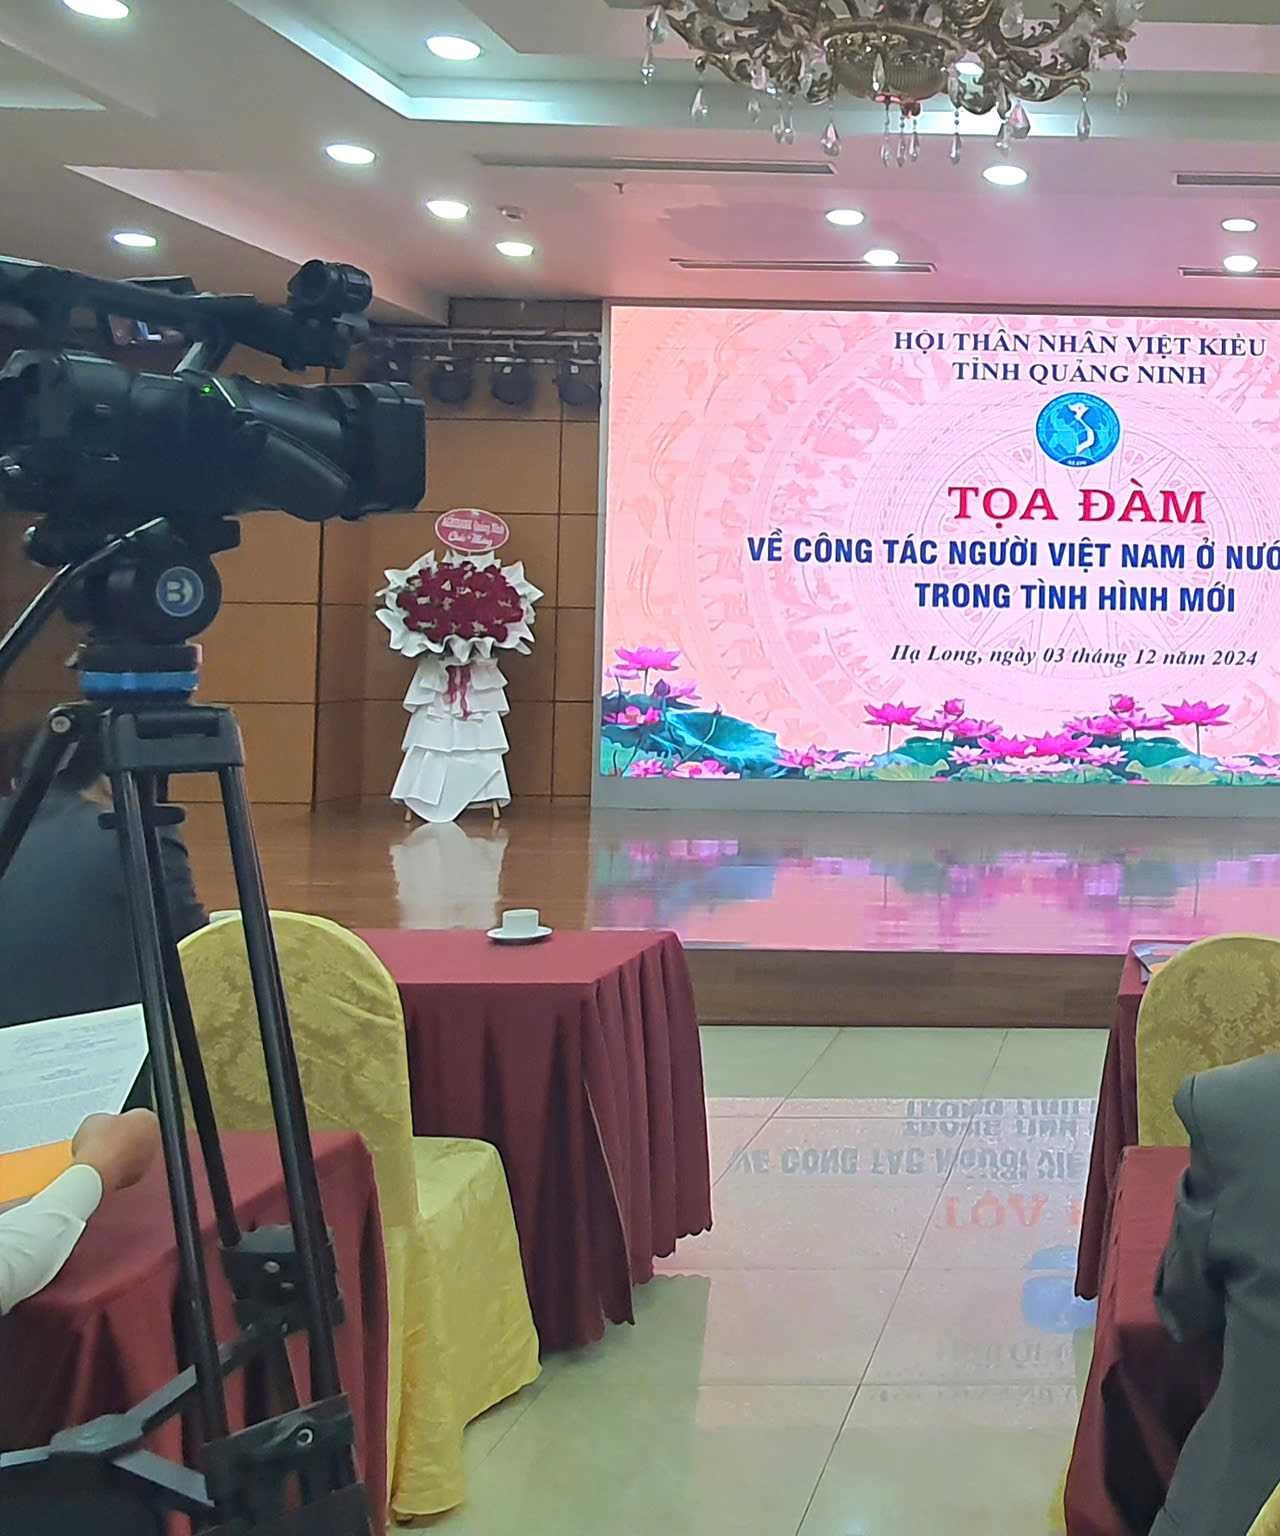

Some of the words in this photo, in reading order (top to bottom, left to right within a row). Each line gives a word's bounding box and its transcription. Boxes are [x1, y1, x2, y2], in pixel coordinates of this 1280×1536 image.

[894, 330, 944, 354] HỘI
[953, 329, 1029, 351] THÂN
[1039, 331, 1117, 353] NHÂN
[1126, 334, 1191, 359] VIỆT
[1029, 359, 1129, 385] QUẢNG
[1137, 365, 1206, 384] NINH
[948, 486, 1058, 529] TỌA
[1078, 478, 1206, 524] ĐÀM
[747, 528, 783, 562] VỀ
[793, 532, 873, 564] CÔNG
[883, 533, 938, 565] TÁC
[949, 536, 1037, 567] NGƯỜI
[1048, 537, 1111, 573] VIỆT
[1121, 543, 1185, 569] NAM
[1196, 537, 1215, 570] Ở
[915, 582, 1010, 609] TRONG
[1020, 578, 1087, 611] TÌNH
[1098, 579, 1168, 612] HÌNH
[1179, 581, 1235, 613] MỚI
[891, 645, 920, 664] Hạ
[927, 646, 983, 665] Long,
[989, 647, 1036, 666] ngày
[1042, 648, 1065, 663] 03
[1071, 648, 1127, 668] tháng
[1134, 649, 1157, 665] 12
[1162, 651, 1206, 665] năm
[1211, 650, 1258, 666] 2024
